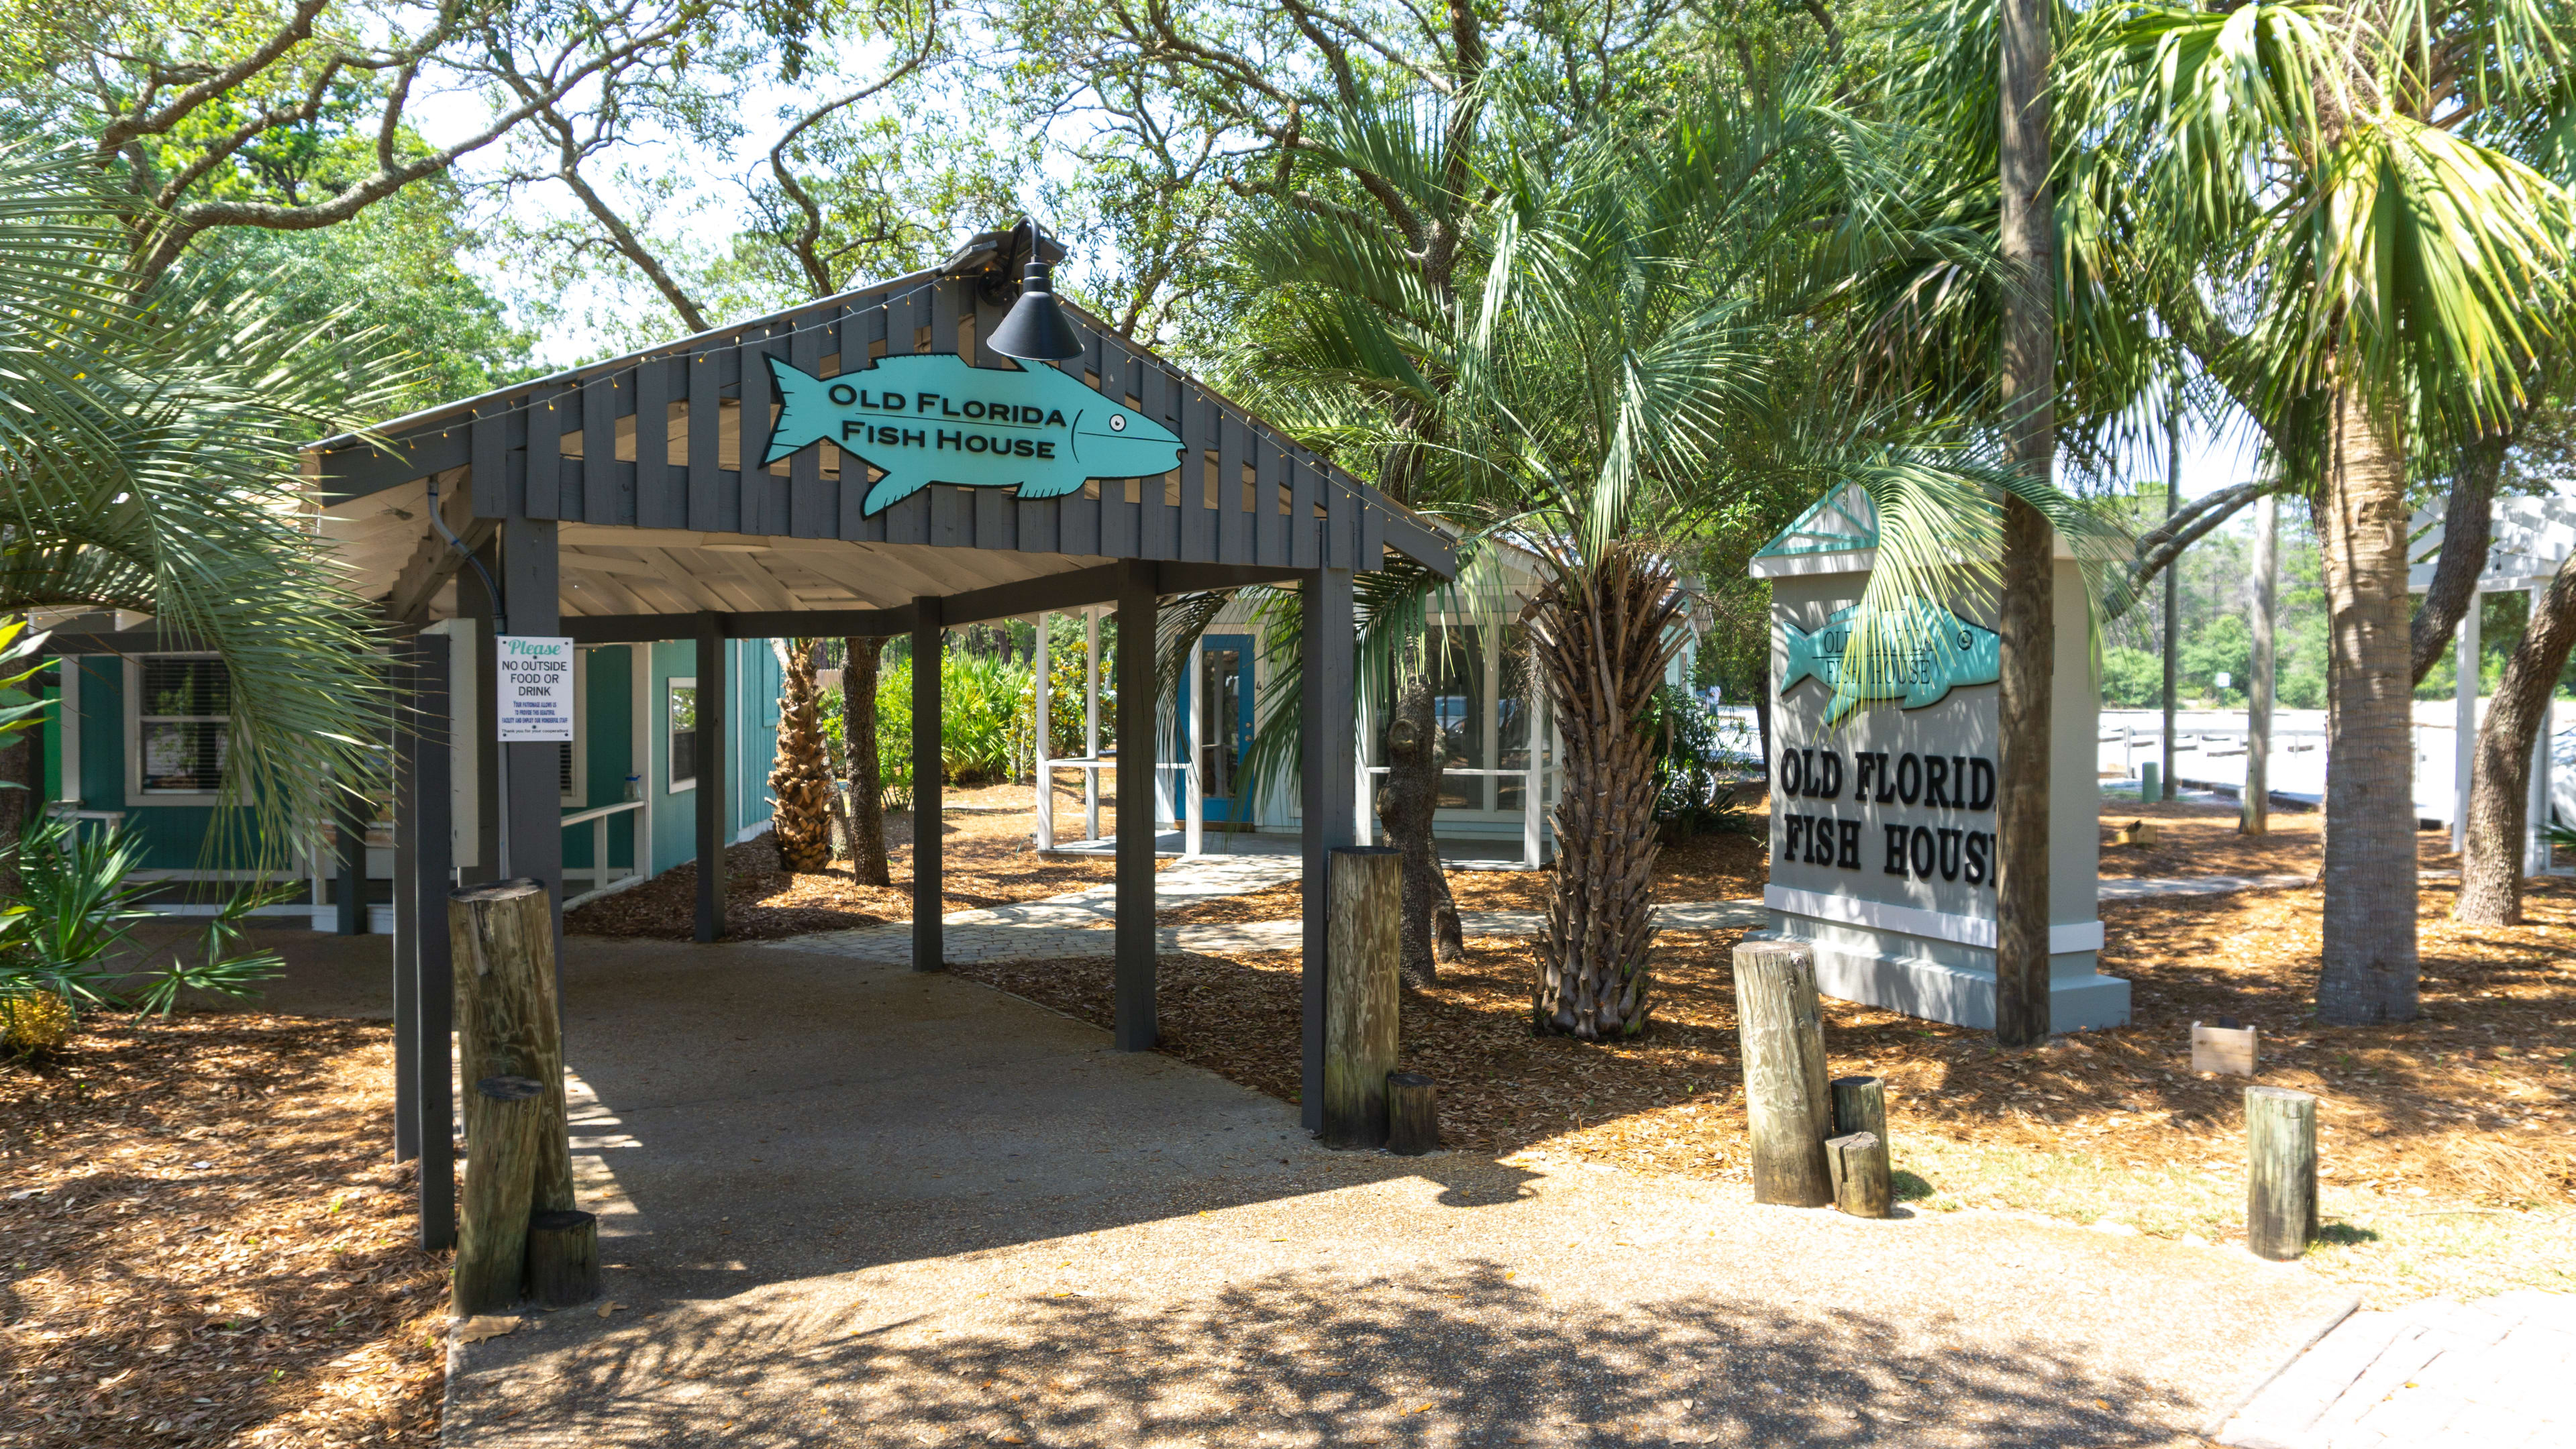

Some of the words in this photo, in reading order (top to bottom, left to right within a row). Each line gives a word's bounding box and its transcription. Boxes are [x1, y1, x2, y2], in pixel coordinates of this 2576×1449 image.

[828, 384, 907, 411] OLD
[917, 392, 1068, 428] FLORIDA
[841, 419, 926, 448] FISH
[937, 429, 1056, 460] HOUSE
[508, 639, 561, 655] Please
[502, 661, 518, 671] NO
[521, 661, 567, 672] OUTSIDE
[511, 673, 541, 684] FOOD
[544, 674, 559, 684] OR
[1256, 681, 1261, 691] 4
[519, 686, 551, 696] DRINK
[1780, 747, 1843, 799] OLD
[1855, 751, 1997, 812] FLORID
[1784, 813, 1861, 870] FISH
